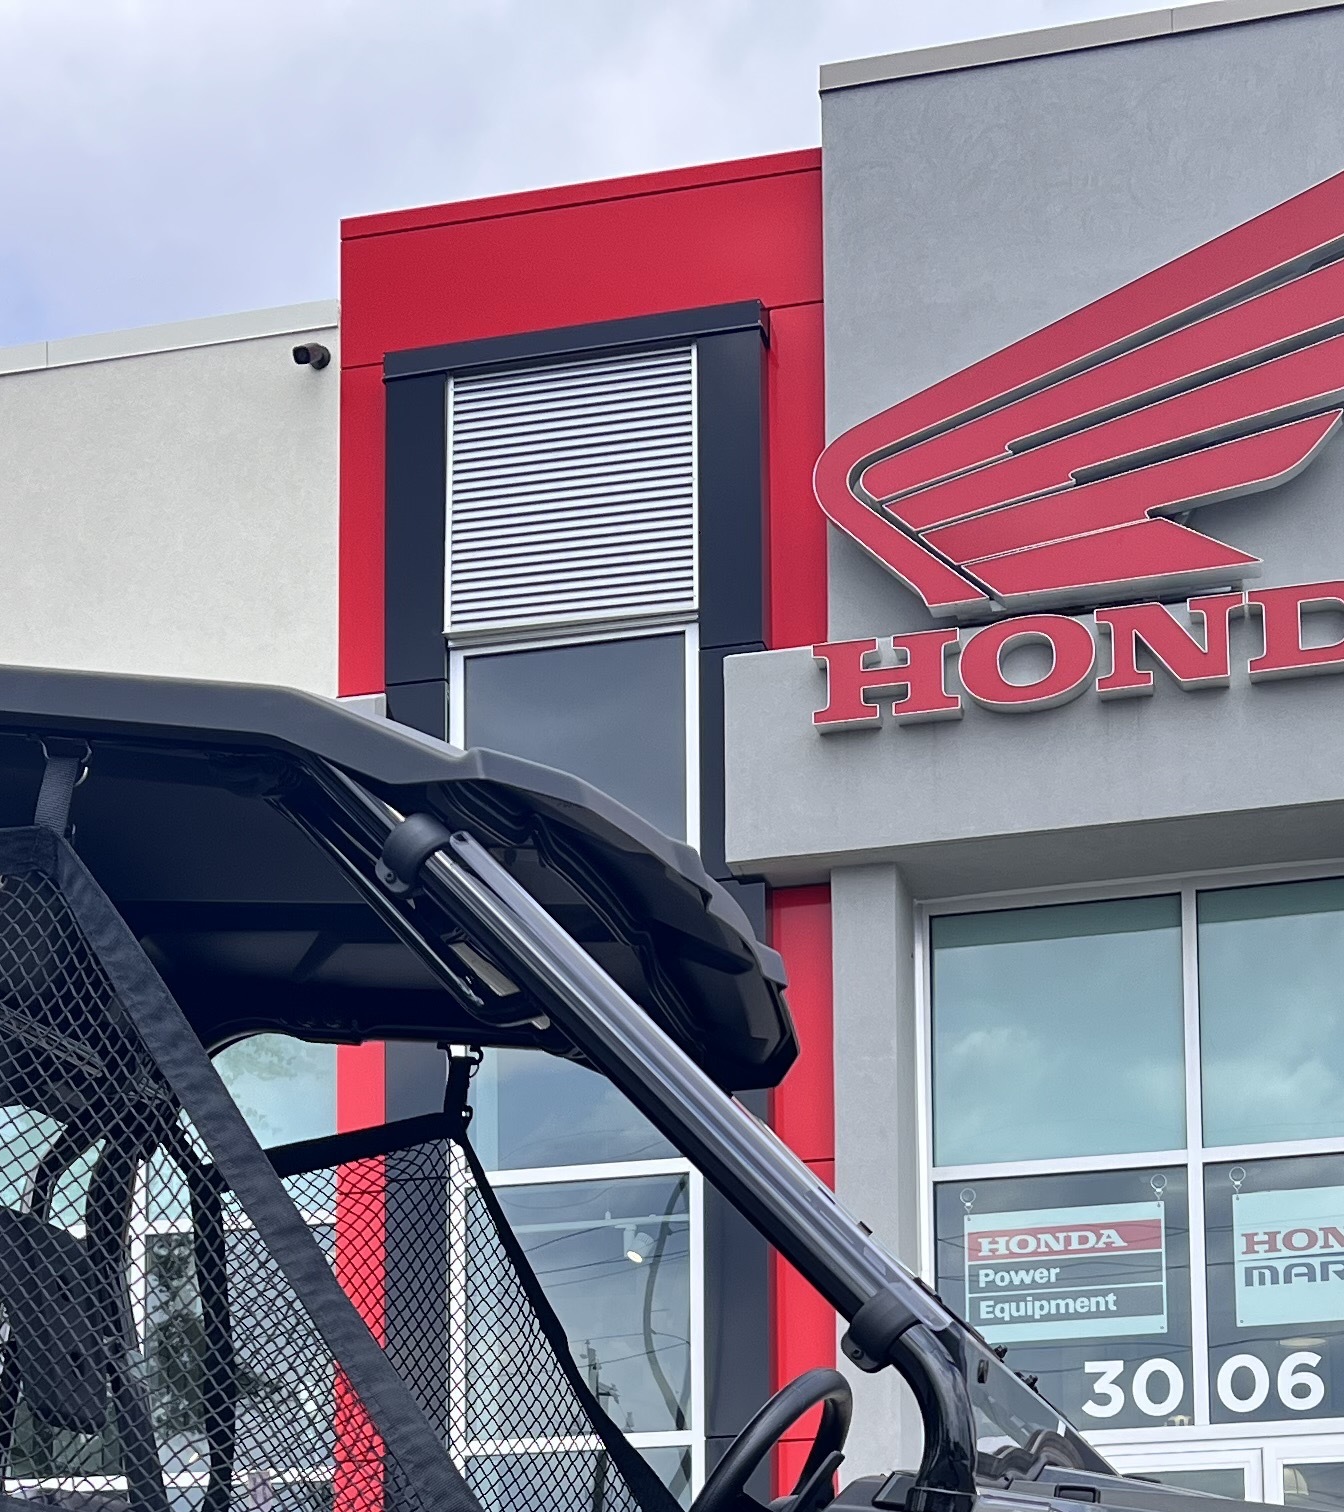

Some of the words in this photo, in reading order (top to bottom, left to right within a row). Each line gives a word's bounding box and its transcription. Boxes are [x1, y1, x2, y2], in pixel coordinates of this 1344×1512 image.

[977, 1228, 1128, 1257] HONDA
[978, 1264, 1060, 1288] Power
[979, 1292, 1117, 1321] Equipment
